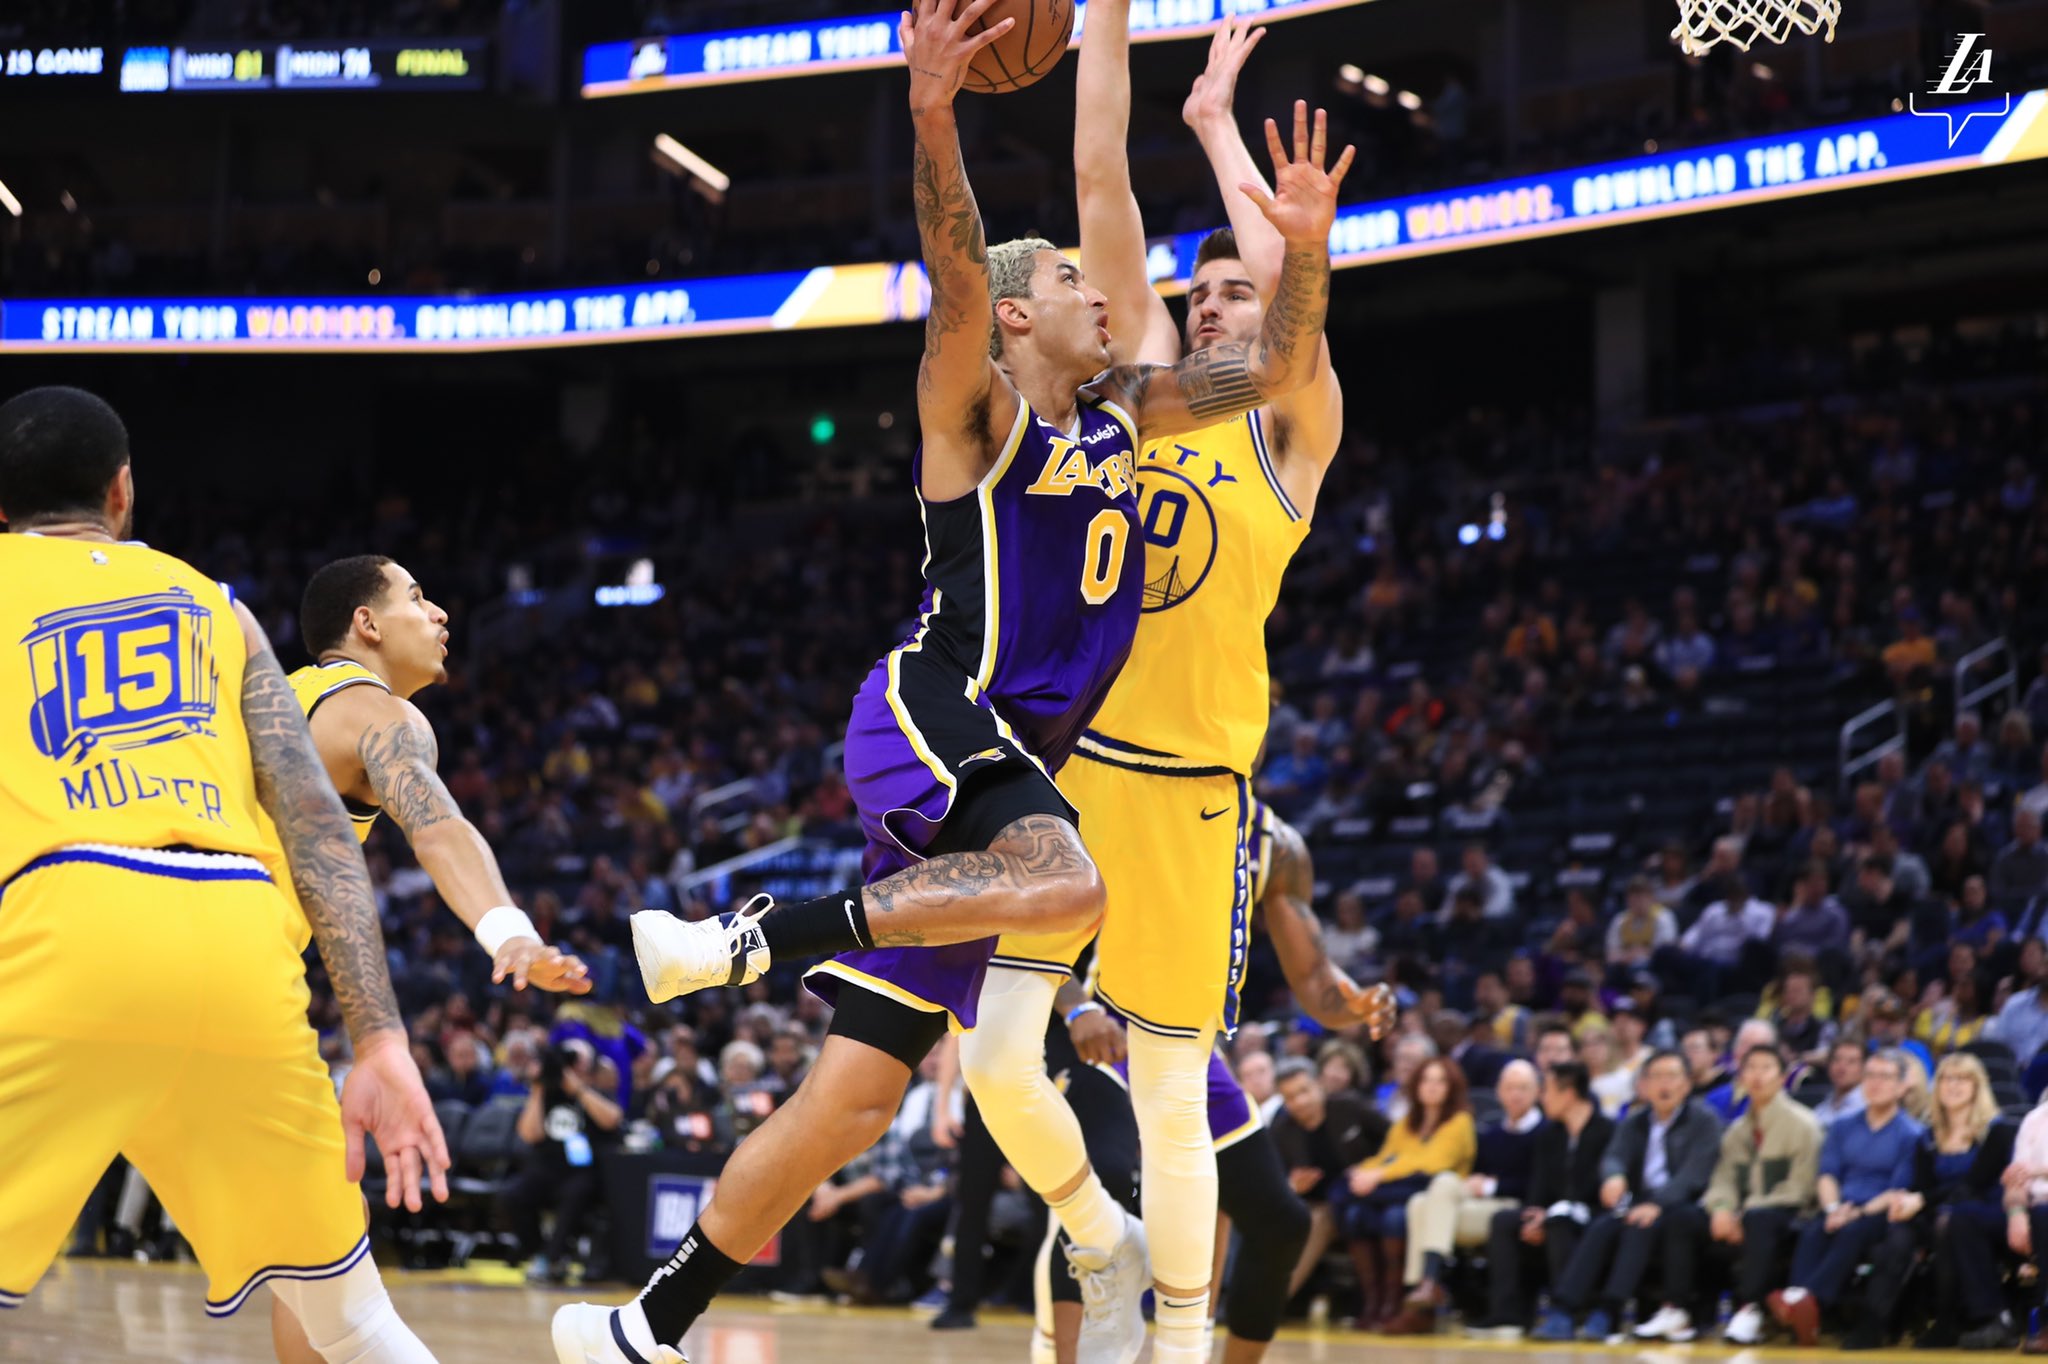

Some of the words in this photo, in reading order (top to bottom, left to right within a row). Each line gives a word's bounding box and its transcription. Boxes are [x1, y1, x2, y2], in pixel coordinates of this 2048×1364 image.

[35, 48, 103, 75] GONE
[396, 49, 468, 76] FINAL
[703, 30, 811, 73] STREAM
[817, 21, 891, 60] YOUR
[1573, 154, 1736, 216] DOWNLOAD
[1745, 142, 1805, 188] THE
[1815, 130, 1887, 177] APP.
[42, 307, 153, 341] STREAM
[163, 306, 237, 341] YOUR
[416, 298, 566, 339] DOWNLOAD
[572, 294, 626, 330] THE
[632, 289, 696, 325] APP.
[1081, 423, 1121, 445] wish
[1080, 508, 1130, 605] 0
[75, 623, 173, 719] 15
